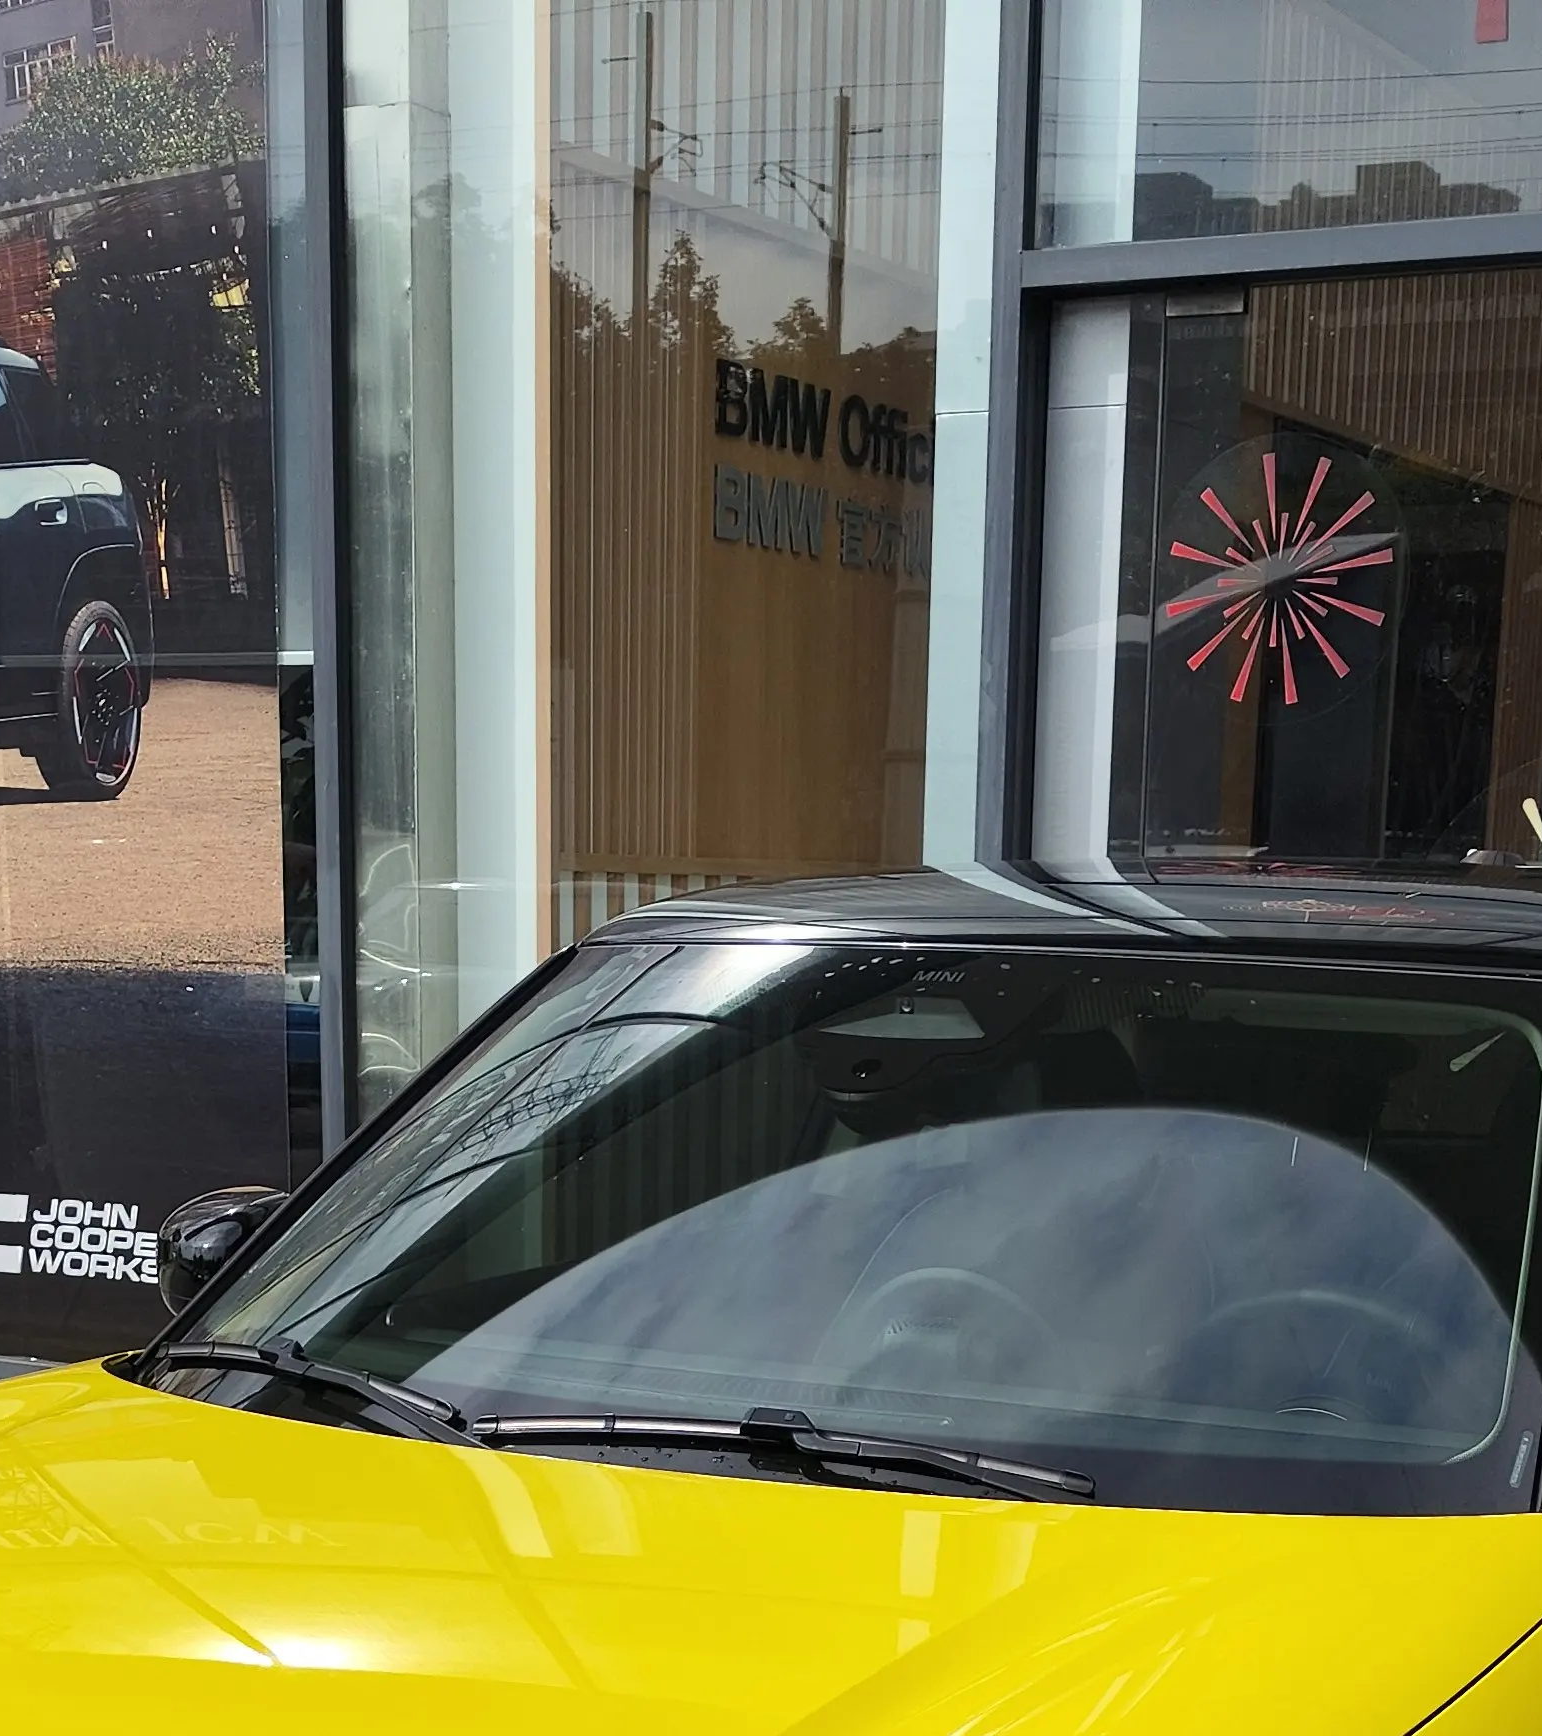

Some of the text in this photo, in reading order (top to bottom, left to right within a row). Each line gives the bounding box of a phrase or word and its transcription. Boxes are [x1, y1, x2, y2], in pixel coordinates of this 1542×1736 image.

[714, 357, 935, 487] BMW Offic
[713, 463, 829, 562] BMW
[912, 970, 966, 984] MINI
[32, 1198, 139, 1230] JOHN
[28, 1247, 159, 1285] WORKS
